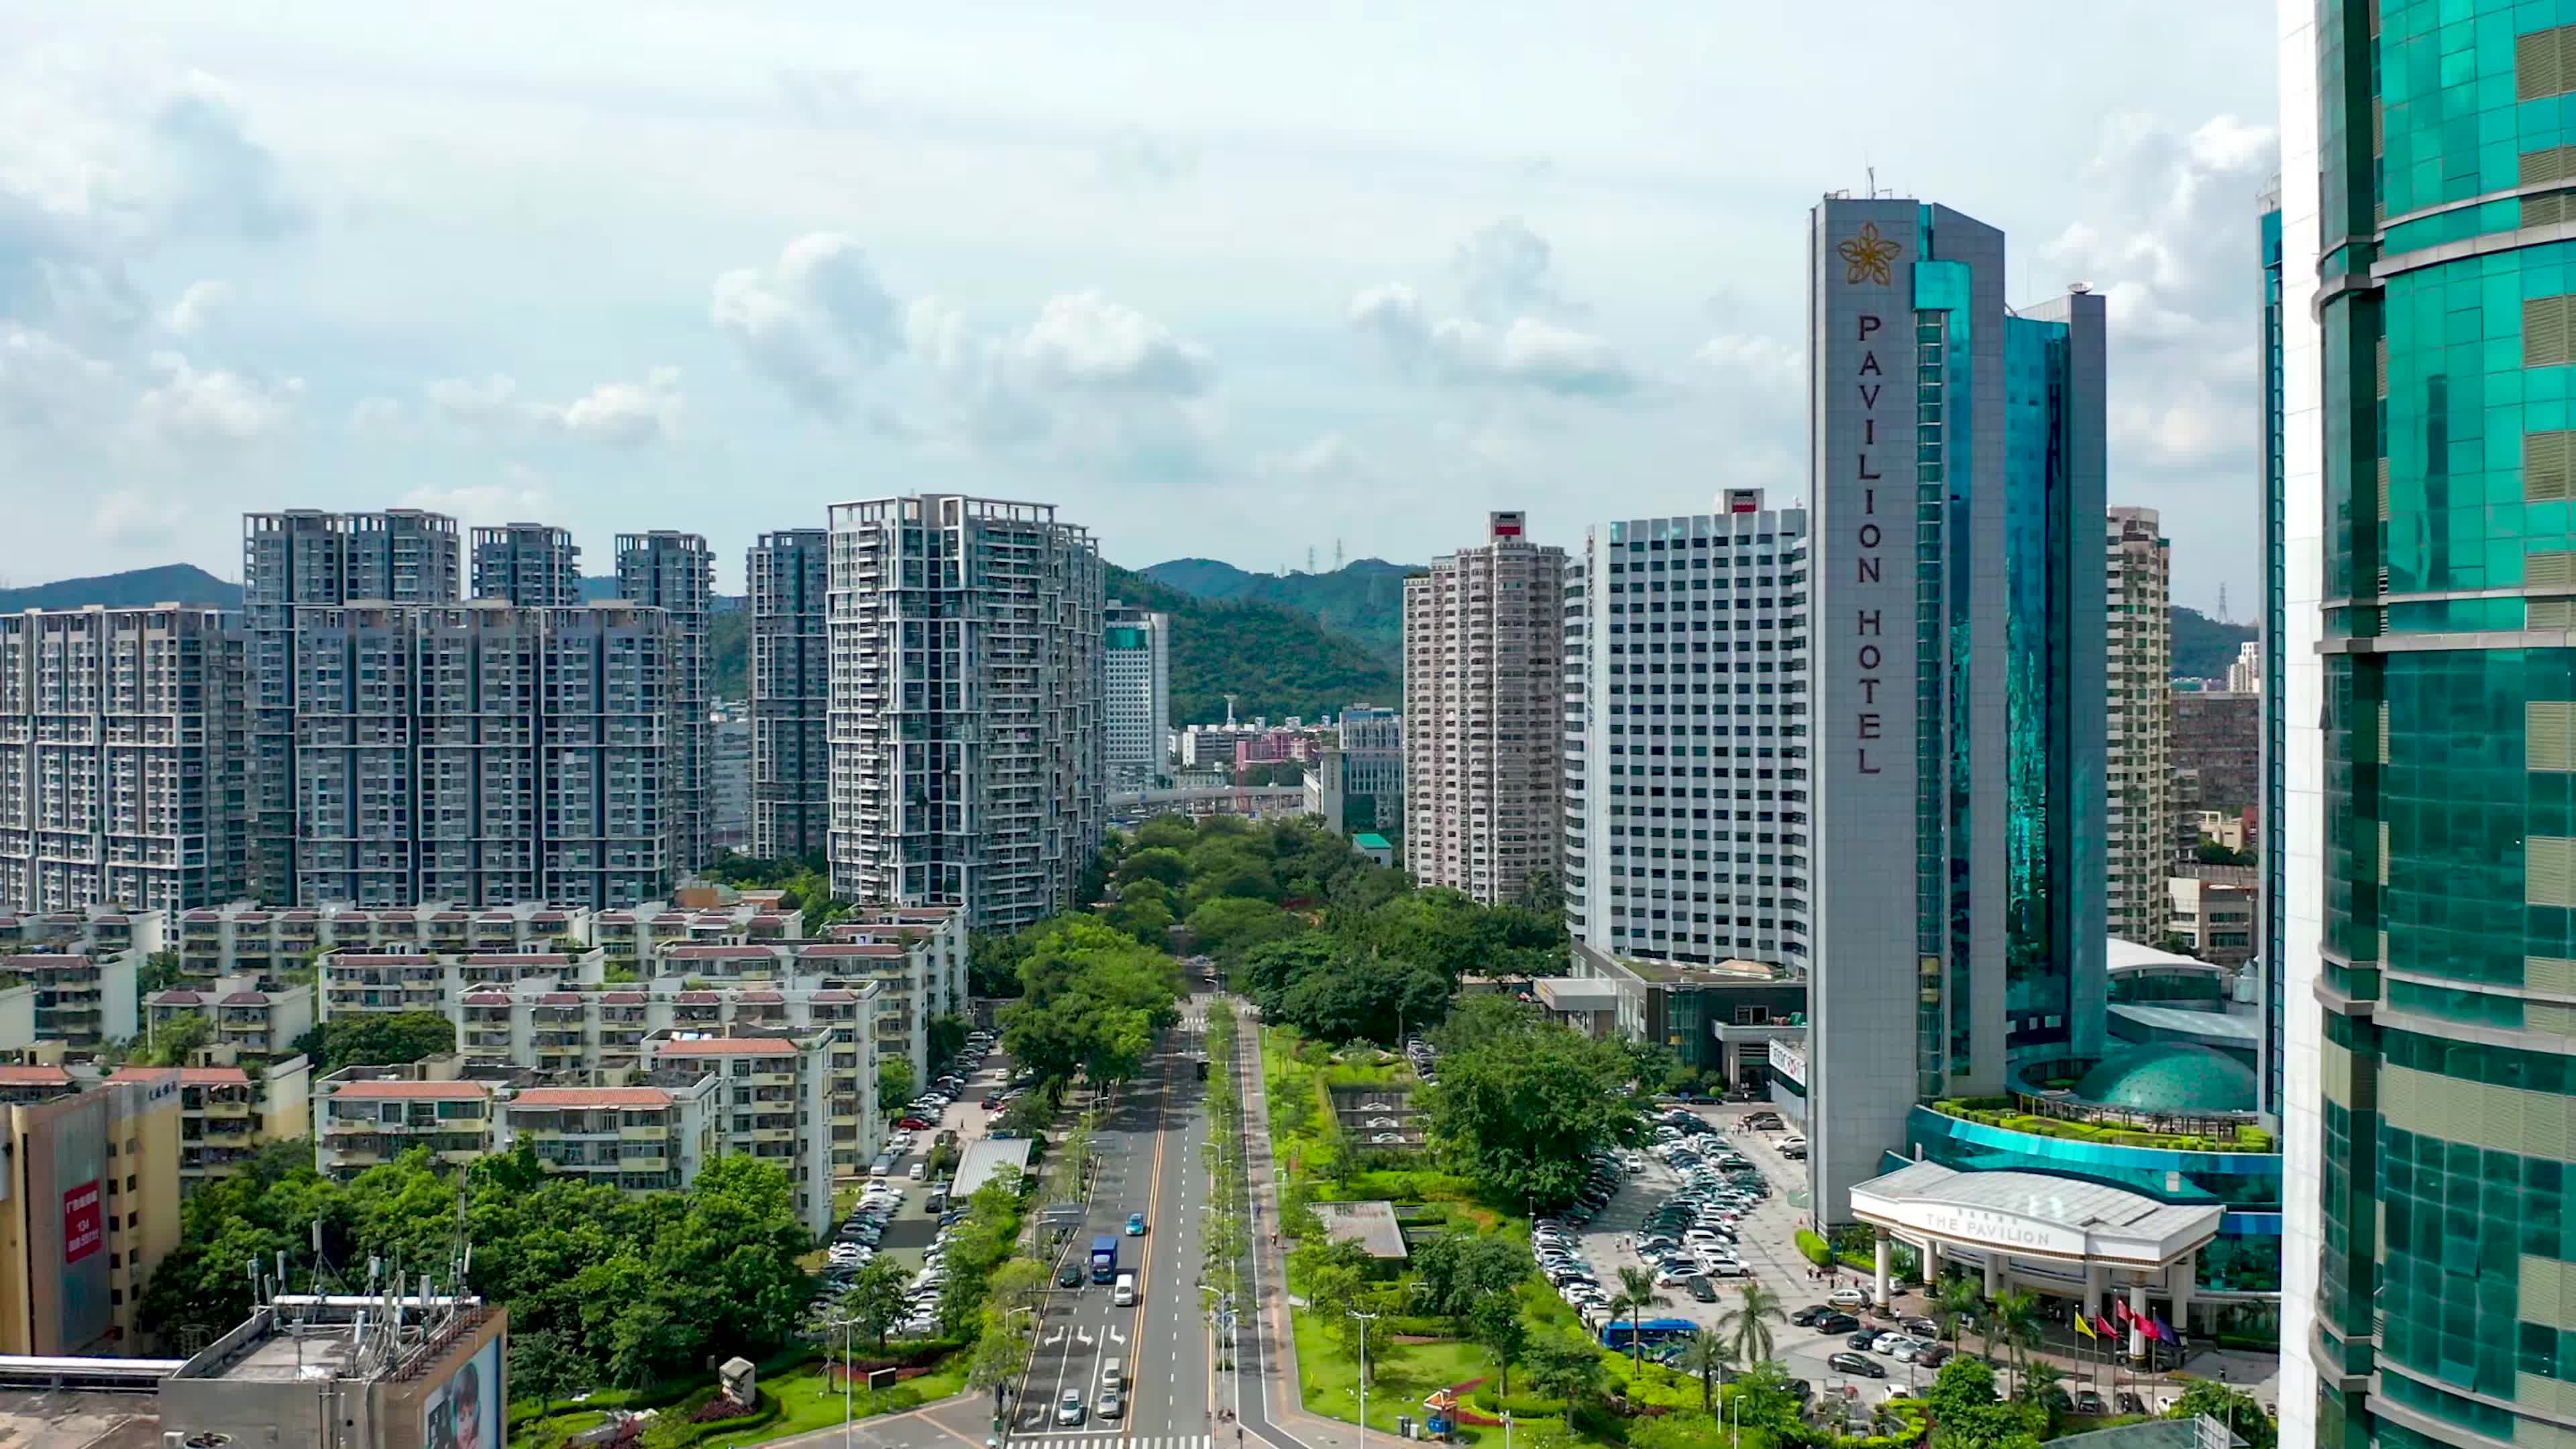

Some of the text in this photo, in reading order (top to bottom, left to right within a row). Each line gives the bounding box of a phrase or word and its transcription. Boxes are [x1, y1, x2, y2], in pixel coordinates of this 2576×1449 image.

[1858, 316, 1882, 773] PAVILION HOTEL
[1927, 1214, 2049, 1246] THE PAVILION
